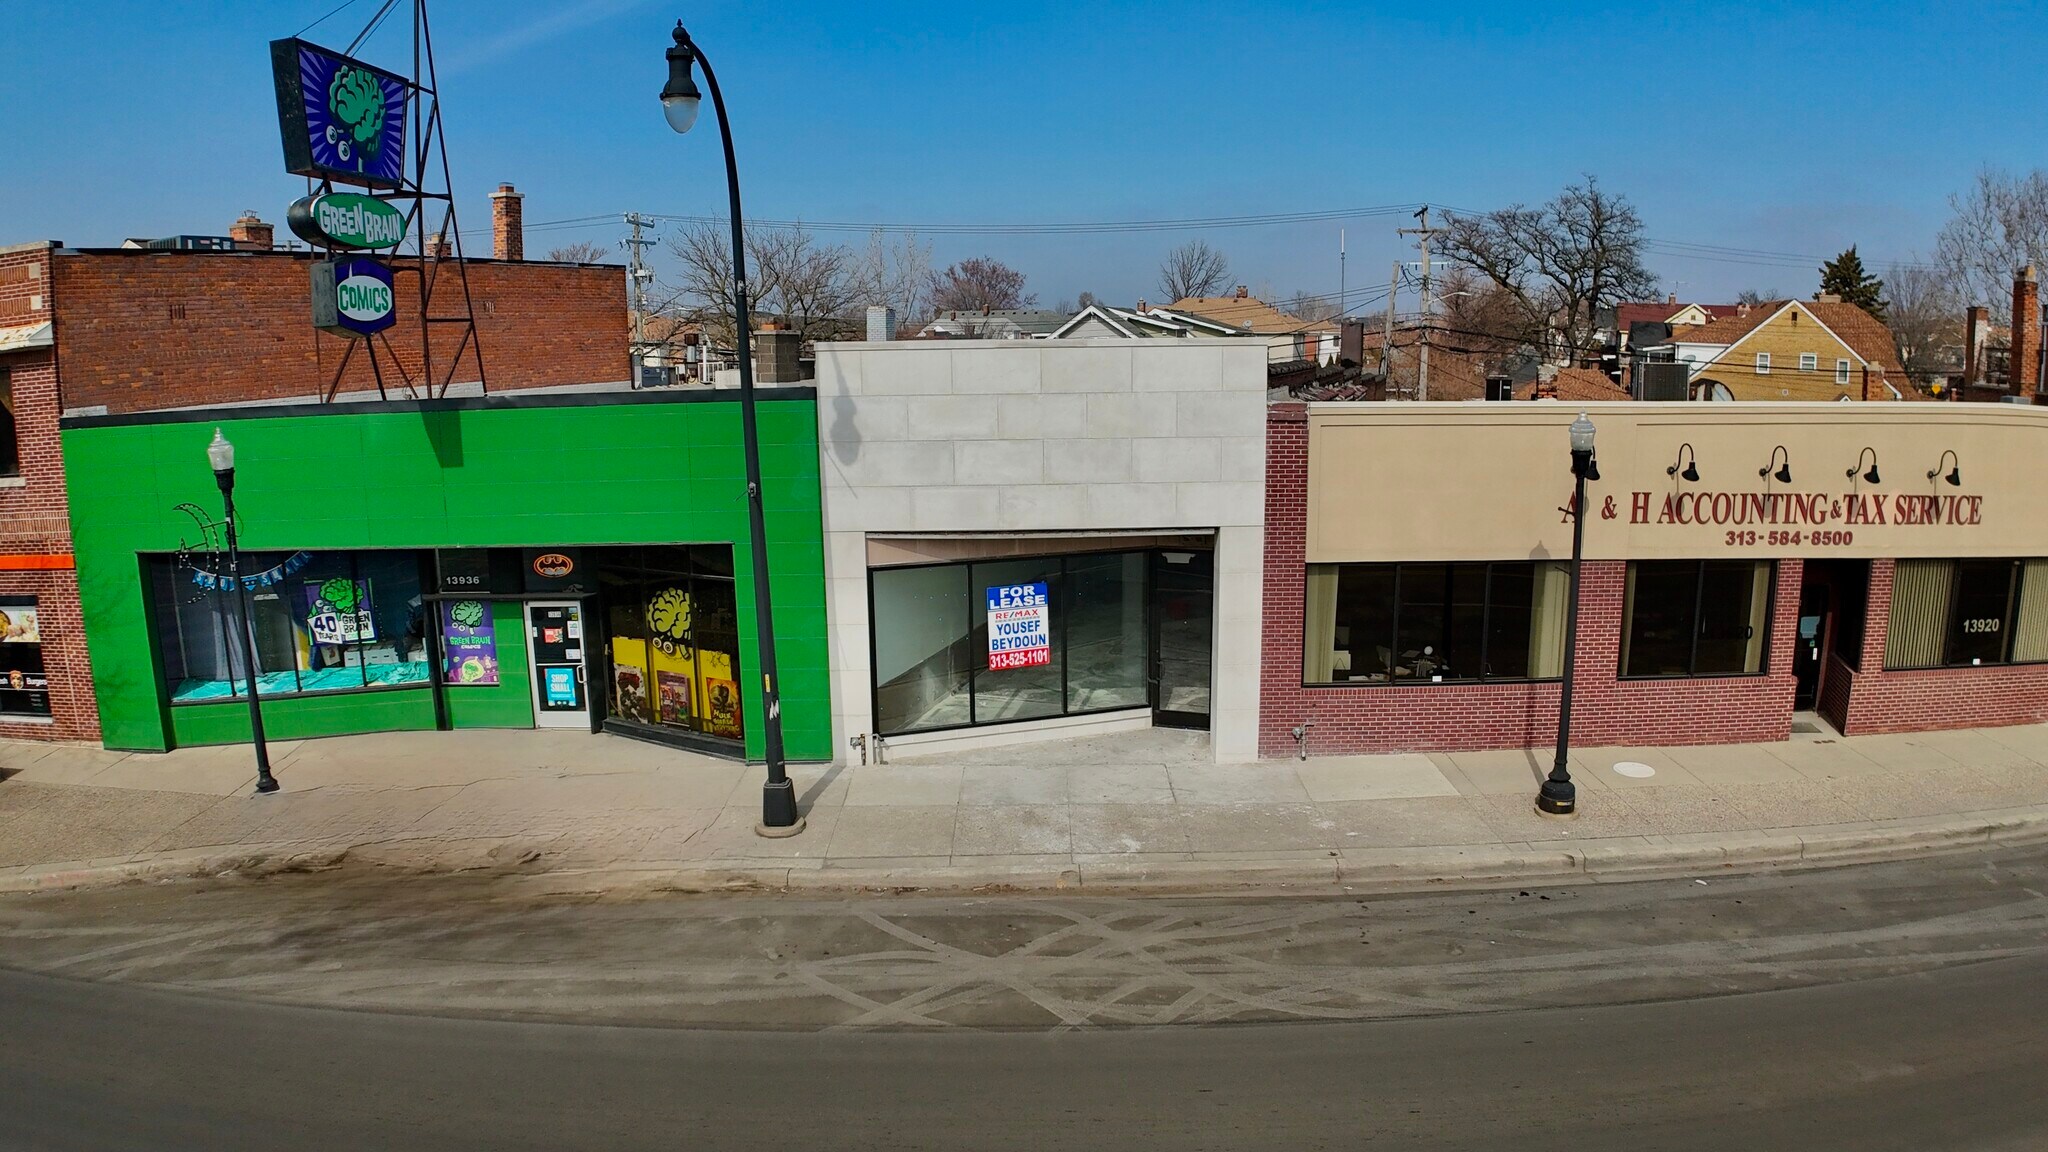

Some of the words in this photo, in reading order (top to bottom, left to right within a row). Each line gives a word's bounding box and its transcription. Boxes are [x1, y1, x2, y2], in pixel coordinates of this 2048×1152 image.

[319, 201, 364, 236] GREEN
[364, 210, 401, 244] BRAIN
[339, 284, 389, 312] COMICS
[1601, 494, 1617, 520] &
[1630, 492, 1651, 525] H
[1657, 492, 1828, 525] ACCOUNTING
[1843, 494, 1888, 525] TAX
[1893, 495, 1982, 525] SERVICE
[1725, 530, 1853, 547] 313-584-8500
[446, 576, 480, 585] 13936
[1000, 585, 1035, 598] FOR
[989, 594, 1046, 609] LEASE
[995, 609, 1039, 620] RE/MAX
[314, 616, 337, 632] 40
[996, 620, 1041, 636] YOUSEF
[1963, 618, 1999, 633] 13920
[449, 636, 470, 645] GREEN
[471, 636, 491, 645] BRAIN
[991, 633, 1046, 651] BEYDOUN
[990, 650, 1048, 668] 313-525-1101
